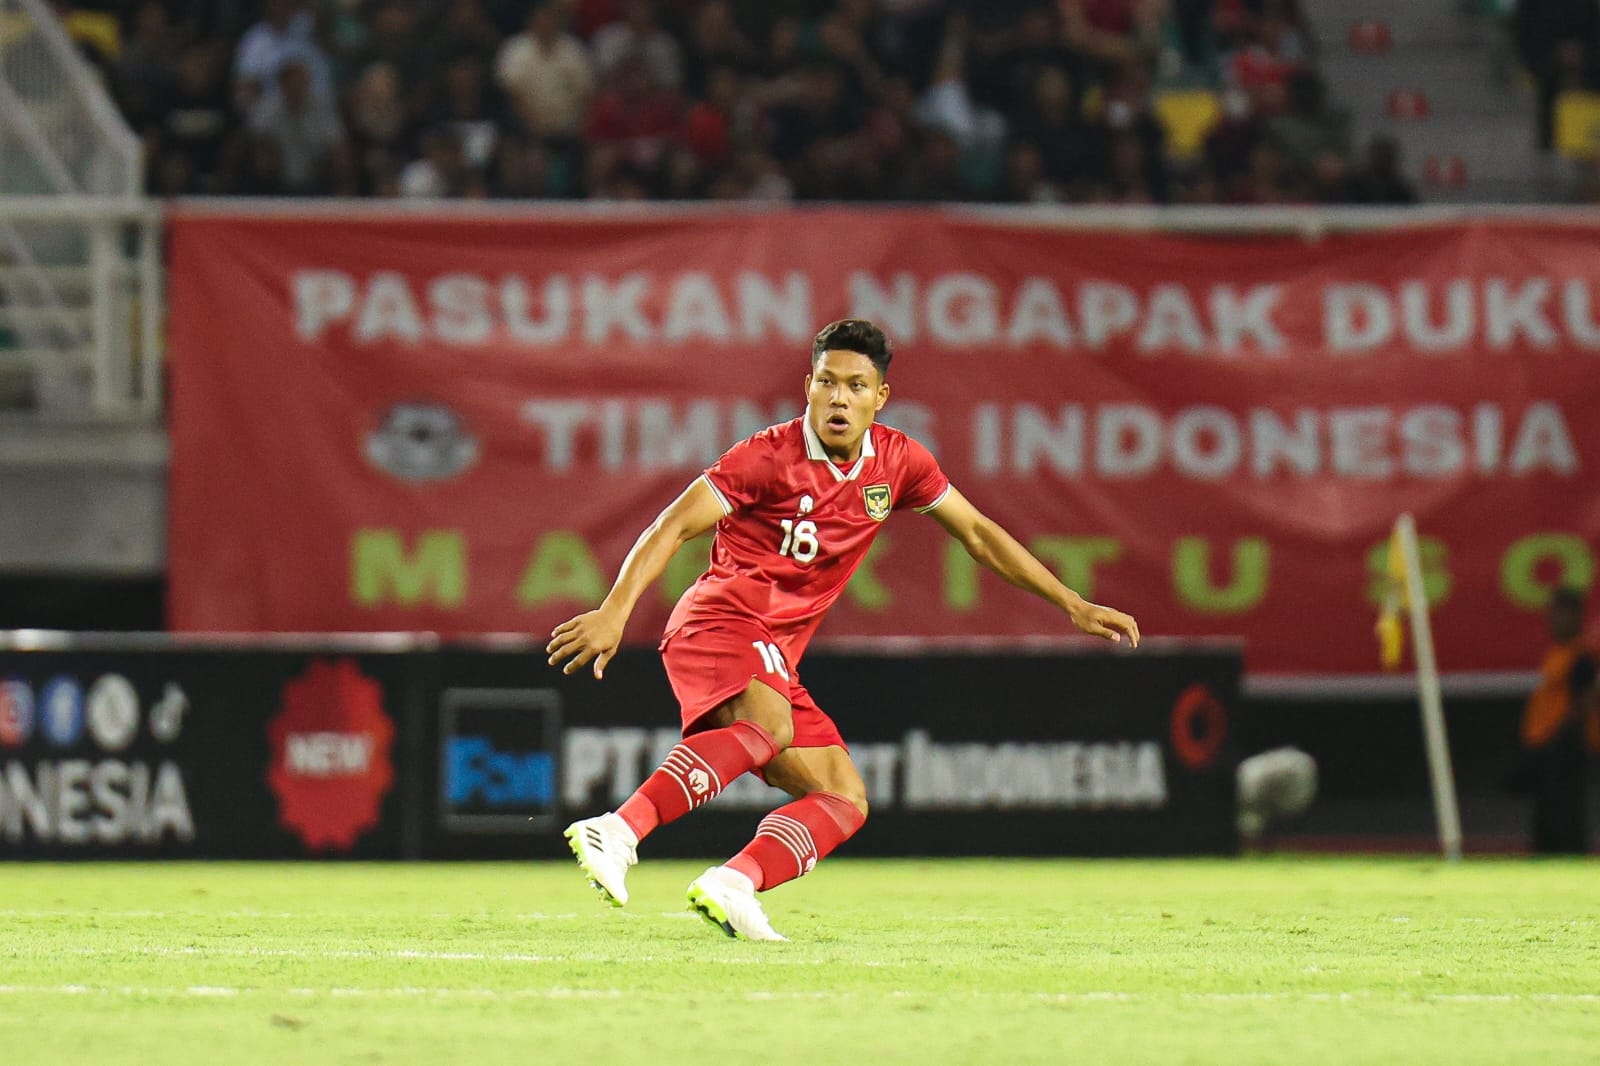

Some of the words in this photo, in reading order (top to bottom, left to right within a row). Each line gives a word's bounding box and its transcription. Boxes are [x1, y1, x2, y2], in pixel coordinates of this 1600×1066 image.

[292, 267, 811, 345] PASUKAN
[850, 270, 1287, 357] NGAPAK
[974, 401, 1578, 478] INDONESIA
[779, 519, 818, 563] 16
[286, 732, 376, 778] NEW
[0, 760, 195, 843] NESIA
